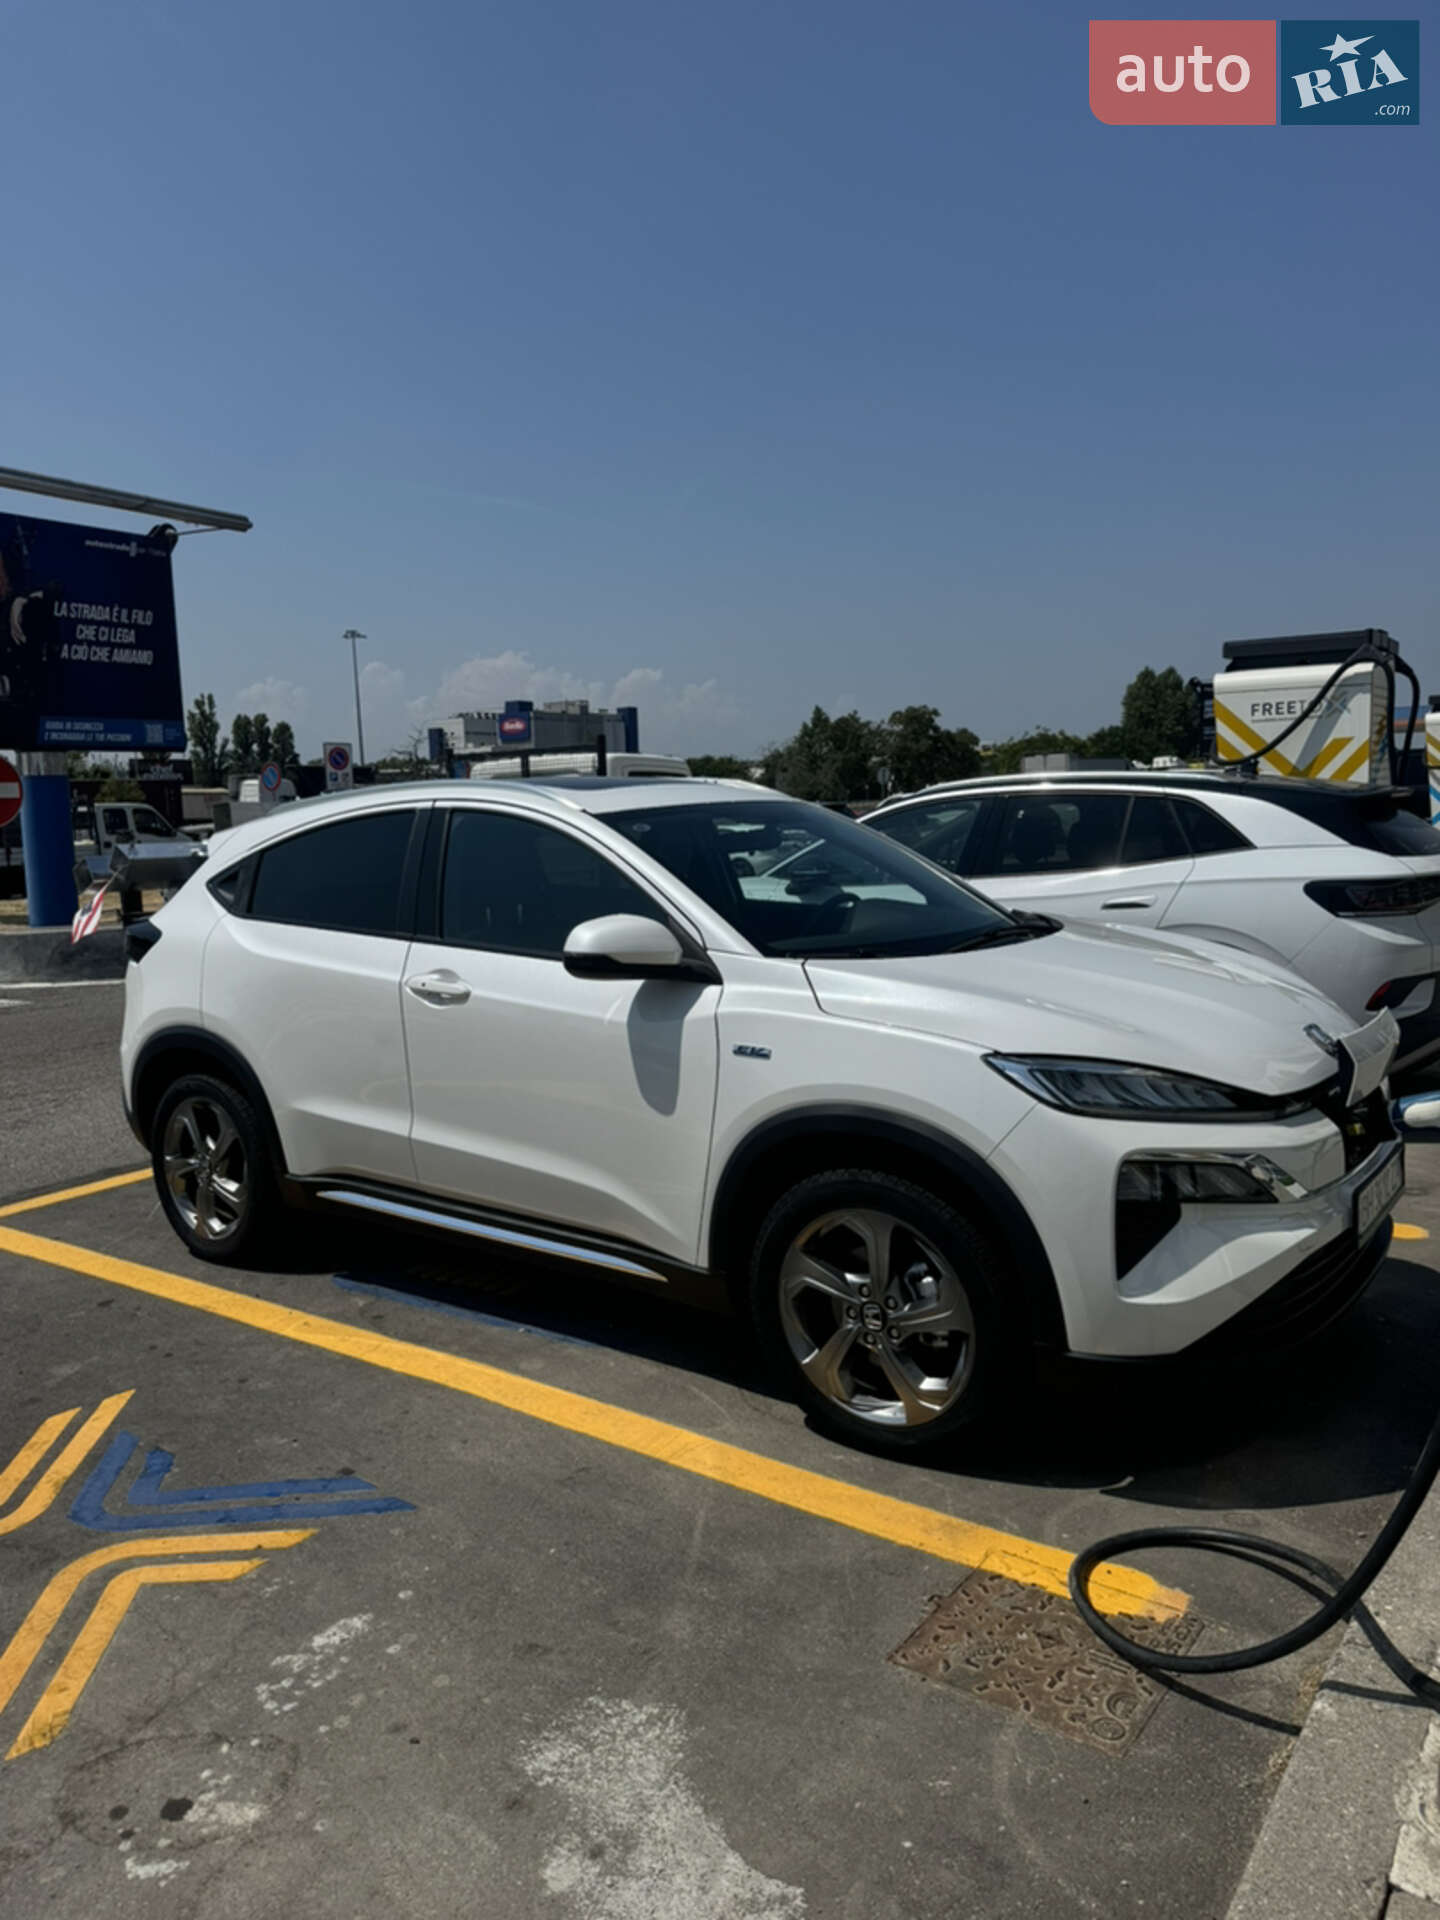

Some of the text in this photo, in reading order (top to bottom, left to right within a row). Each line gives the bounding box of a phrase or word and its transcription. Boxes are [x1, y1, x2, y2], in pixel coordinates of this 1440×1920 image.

[54, 600, 68, 618] LA
[69, 602, 111, 621] STRADA
[131, 608, 153, 626] FILO
[76, 623, 97, 641] CHE
[110, 626, 136, 644] LEGA
[60, 643, 69, 660] A
[90, 645, 111, 662] CHE
